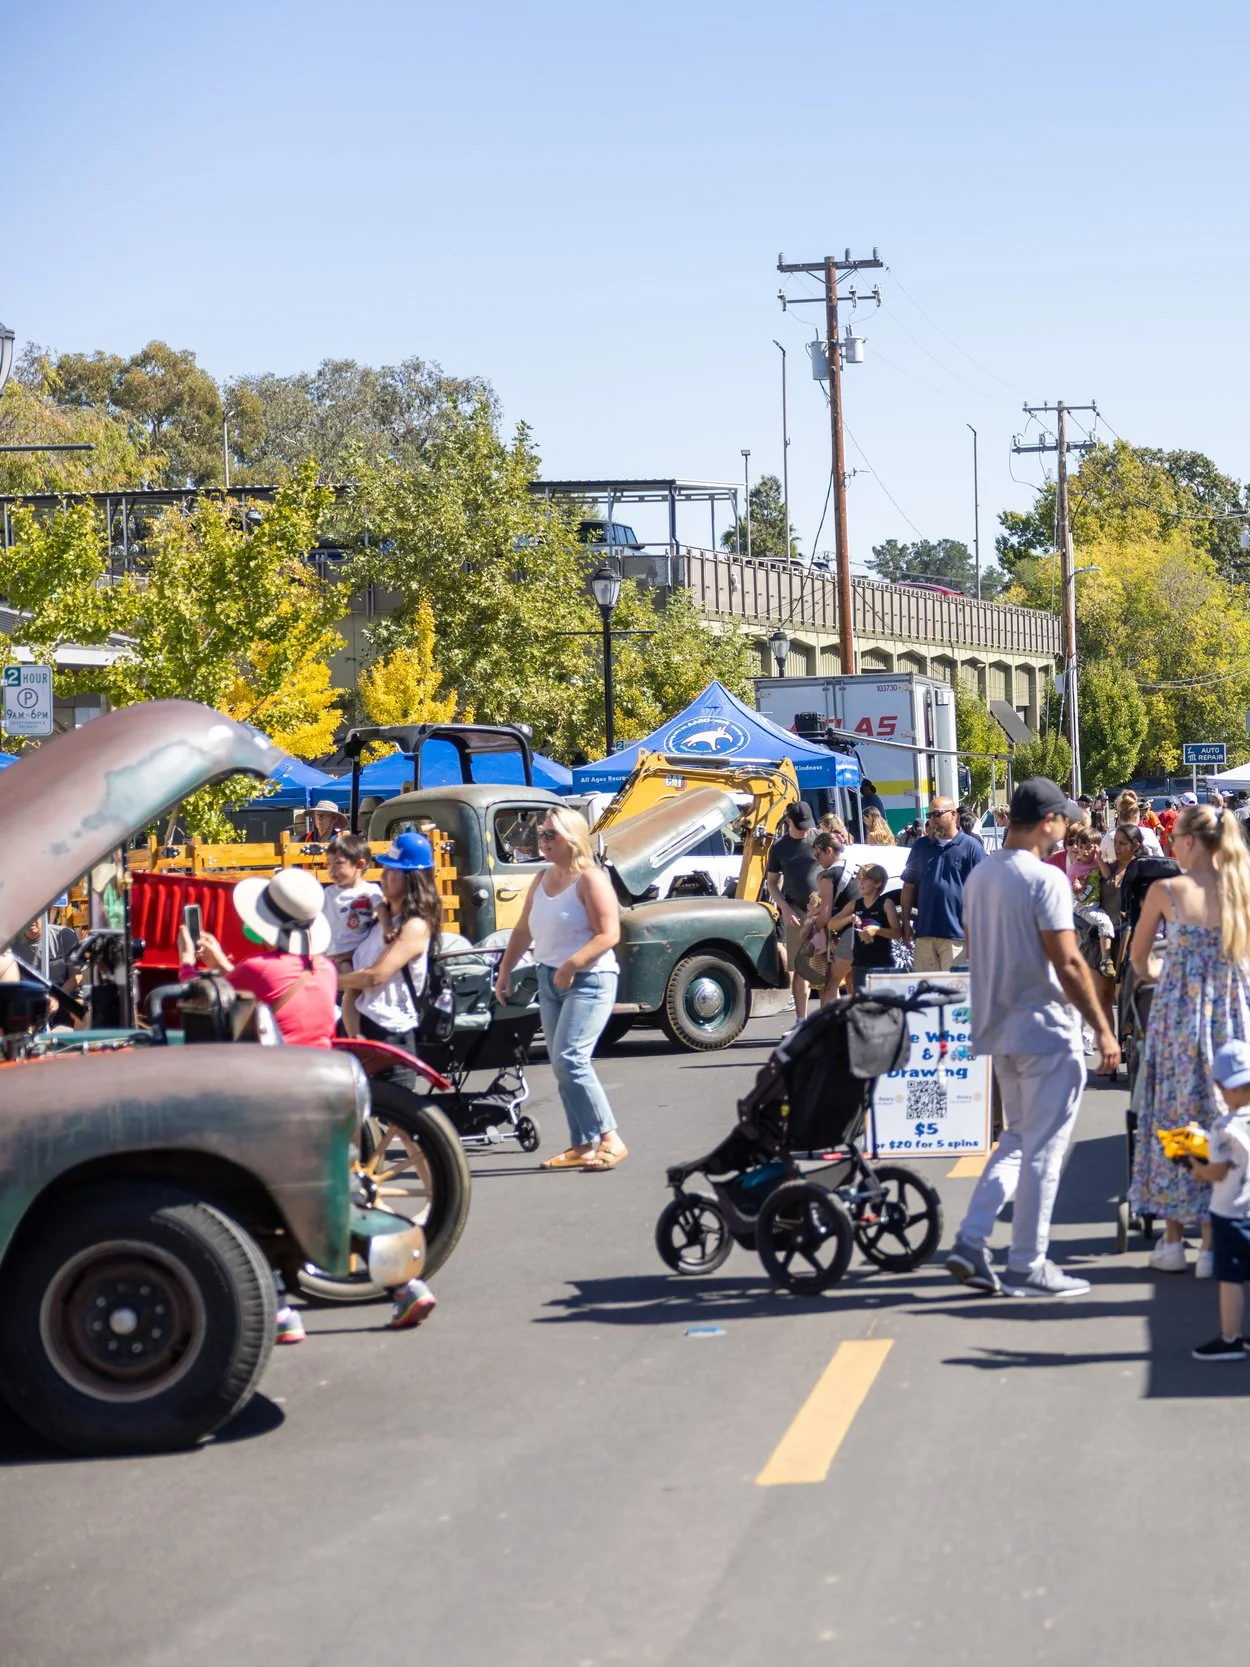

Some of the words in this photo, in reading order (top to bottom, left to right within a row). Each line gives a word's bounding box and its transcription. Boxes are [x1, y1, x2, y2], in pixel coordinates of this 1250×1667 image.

[7, 669, 19, 684] 2
[22, 673, 47, 683] HOUR
[591, 776, 607, 784] Ages
[665, 774, 683, 788] CAT
[922, 1048, 933, 1060] &
[887, 1067, 968, 1079] Drawng
[914, 1122, 939, 1137] $5
[889, 1140, 912, 1149] $20
[916, 1140, 933, 1148] for
[936, 1140, 945, 1148] 5
[948, 1139, 979, 1149] spins
